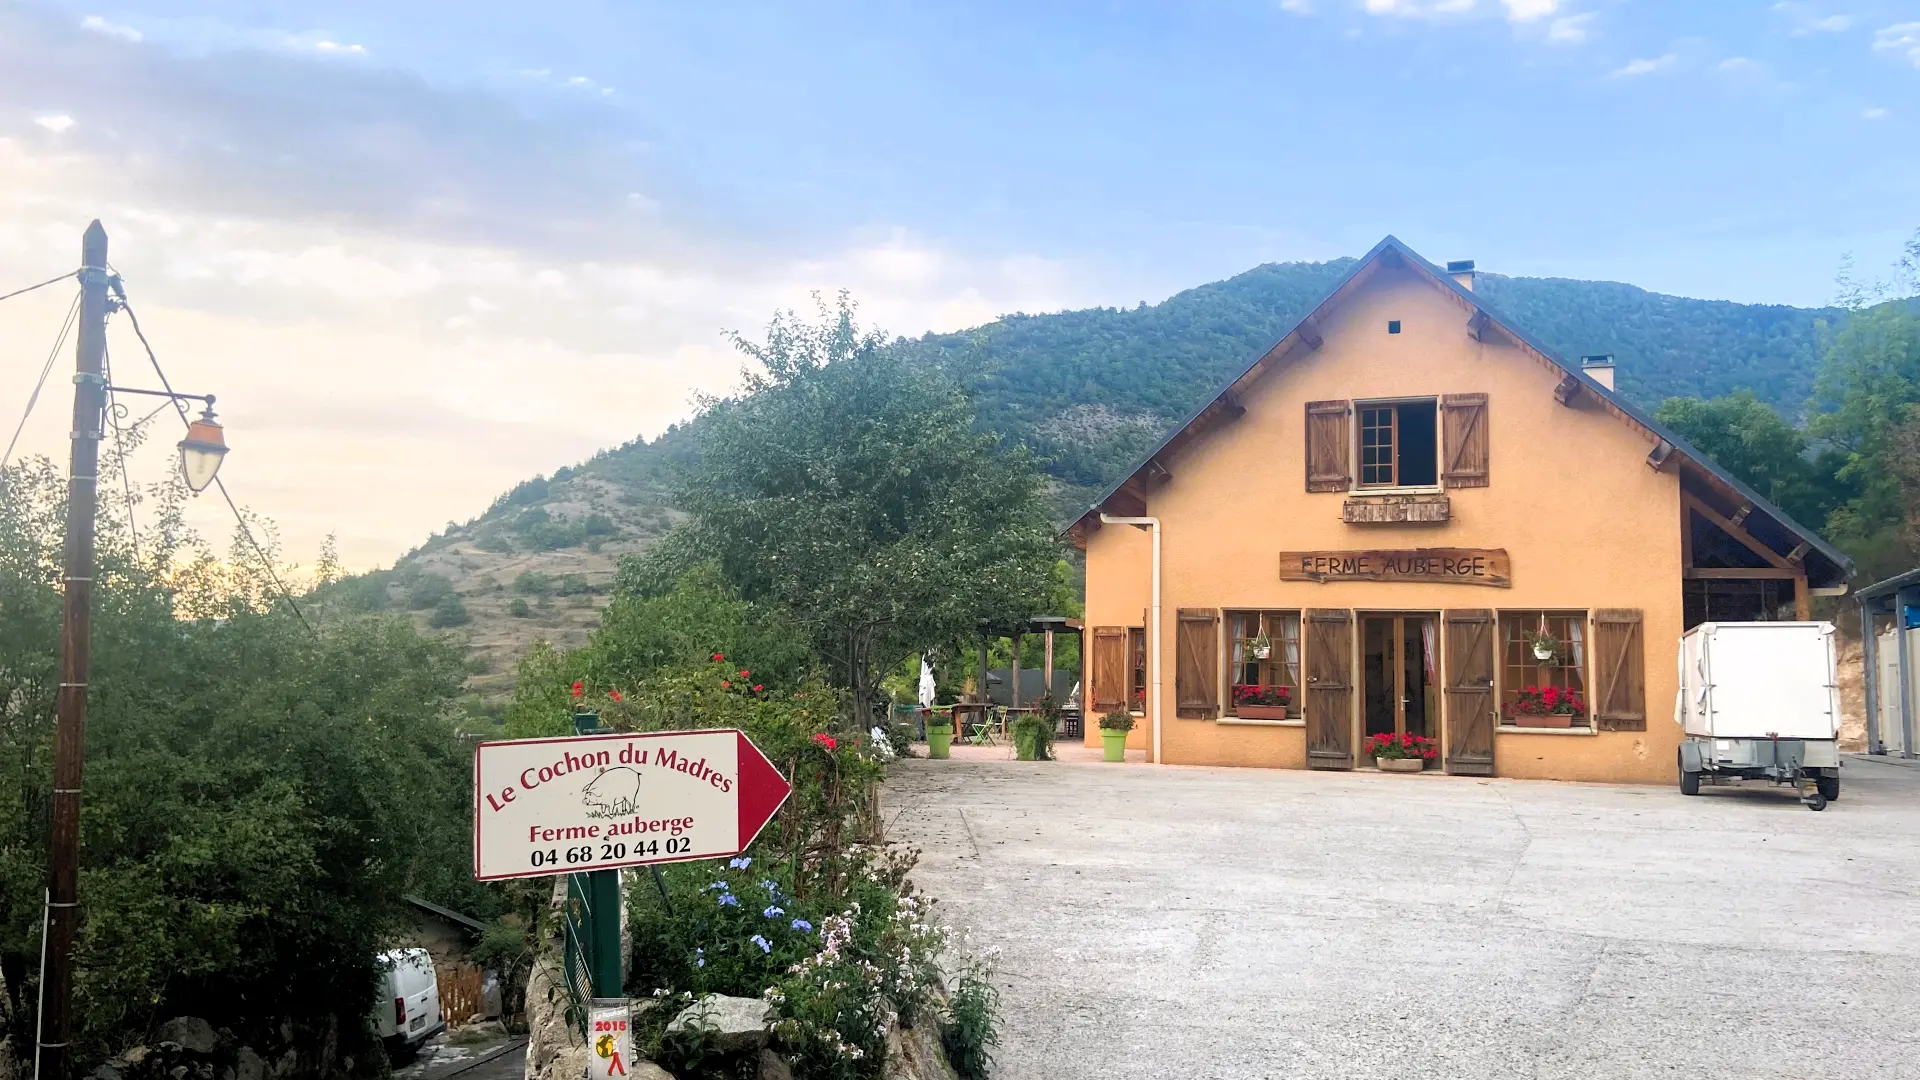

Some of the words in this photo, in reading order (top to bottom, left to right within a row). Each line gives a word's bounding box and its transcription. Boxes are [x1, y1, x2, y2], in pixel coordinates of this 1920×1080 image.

[1301, 557, 1369, 575] FERME
[1383, 556, 1485, 576] AUBERGE
[486, 786, 516, 812] Le
[520, 750, 610, 790] Cochon
[619, 742, 648, 764] du
[655, 747, 733, 793] Madres
[529, 825, 600, 842] Ferme
[607, 816, 694, 837] auberge
[531, 849, 559, 867] 04
[566, 846, 593, 864] 68
[600, 842, 626, 861] 20
[633, 839, 659, 857] 44
[666, 837, 691, 854] 02
[595, 1021, 627, 1031] 2015
